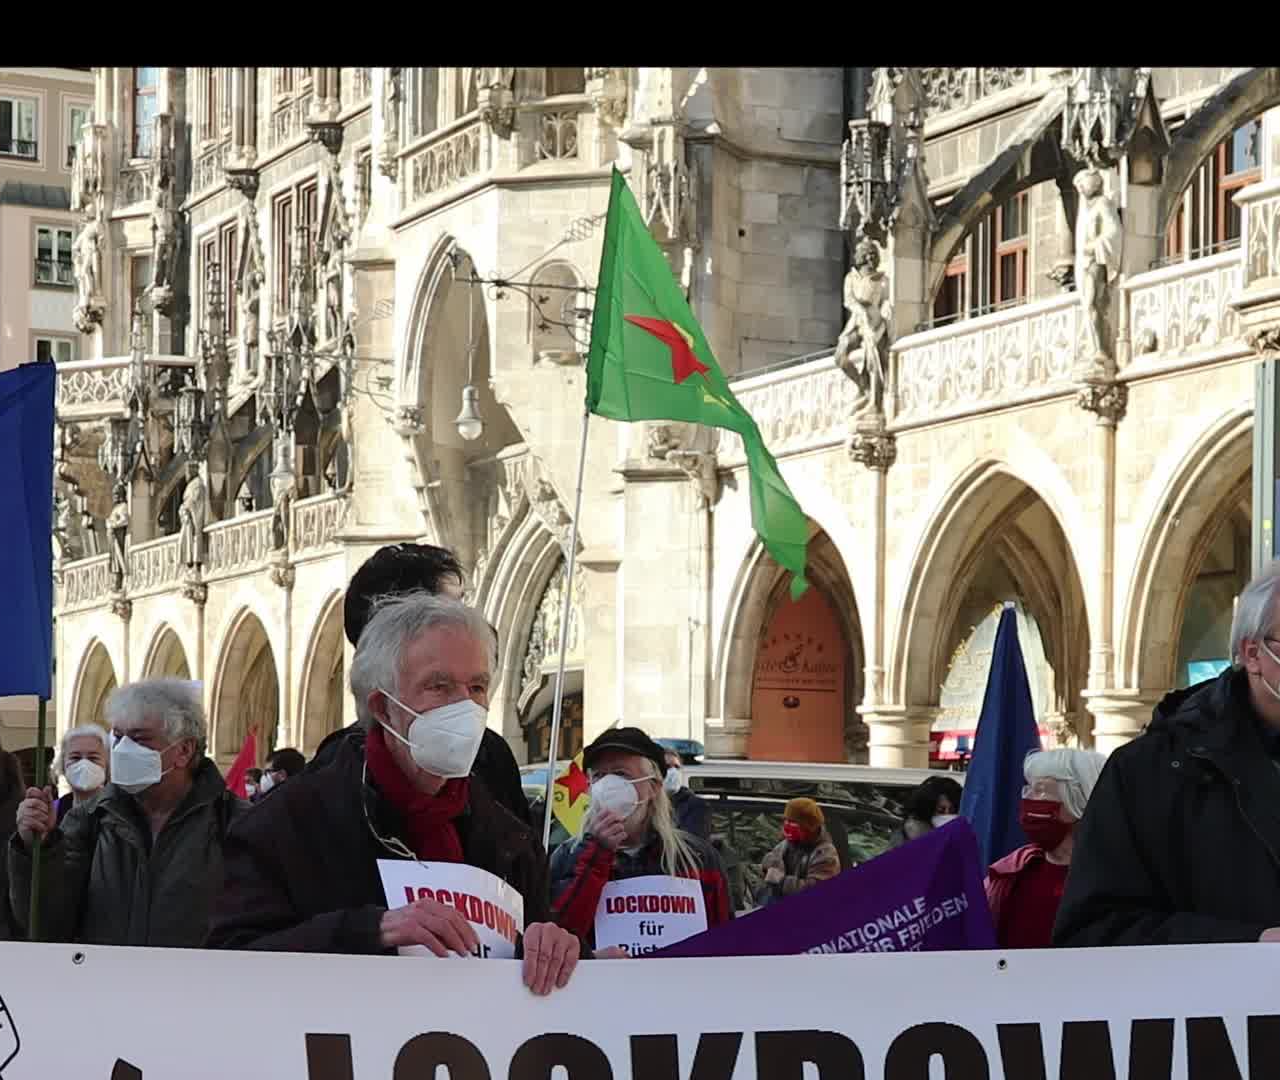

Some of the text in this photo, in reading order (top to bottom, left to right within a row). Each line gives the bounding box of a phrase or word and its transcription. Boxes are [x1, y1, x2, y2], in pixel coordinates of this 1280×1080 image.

[606, 895, 696, 914] LOCKDOWN
[639, 920, 664, 936] für
[898, 892, 970, 947] FRIEDEN
